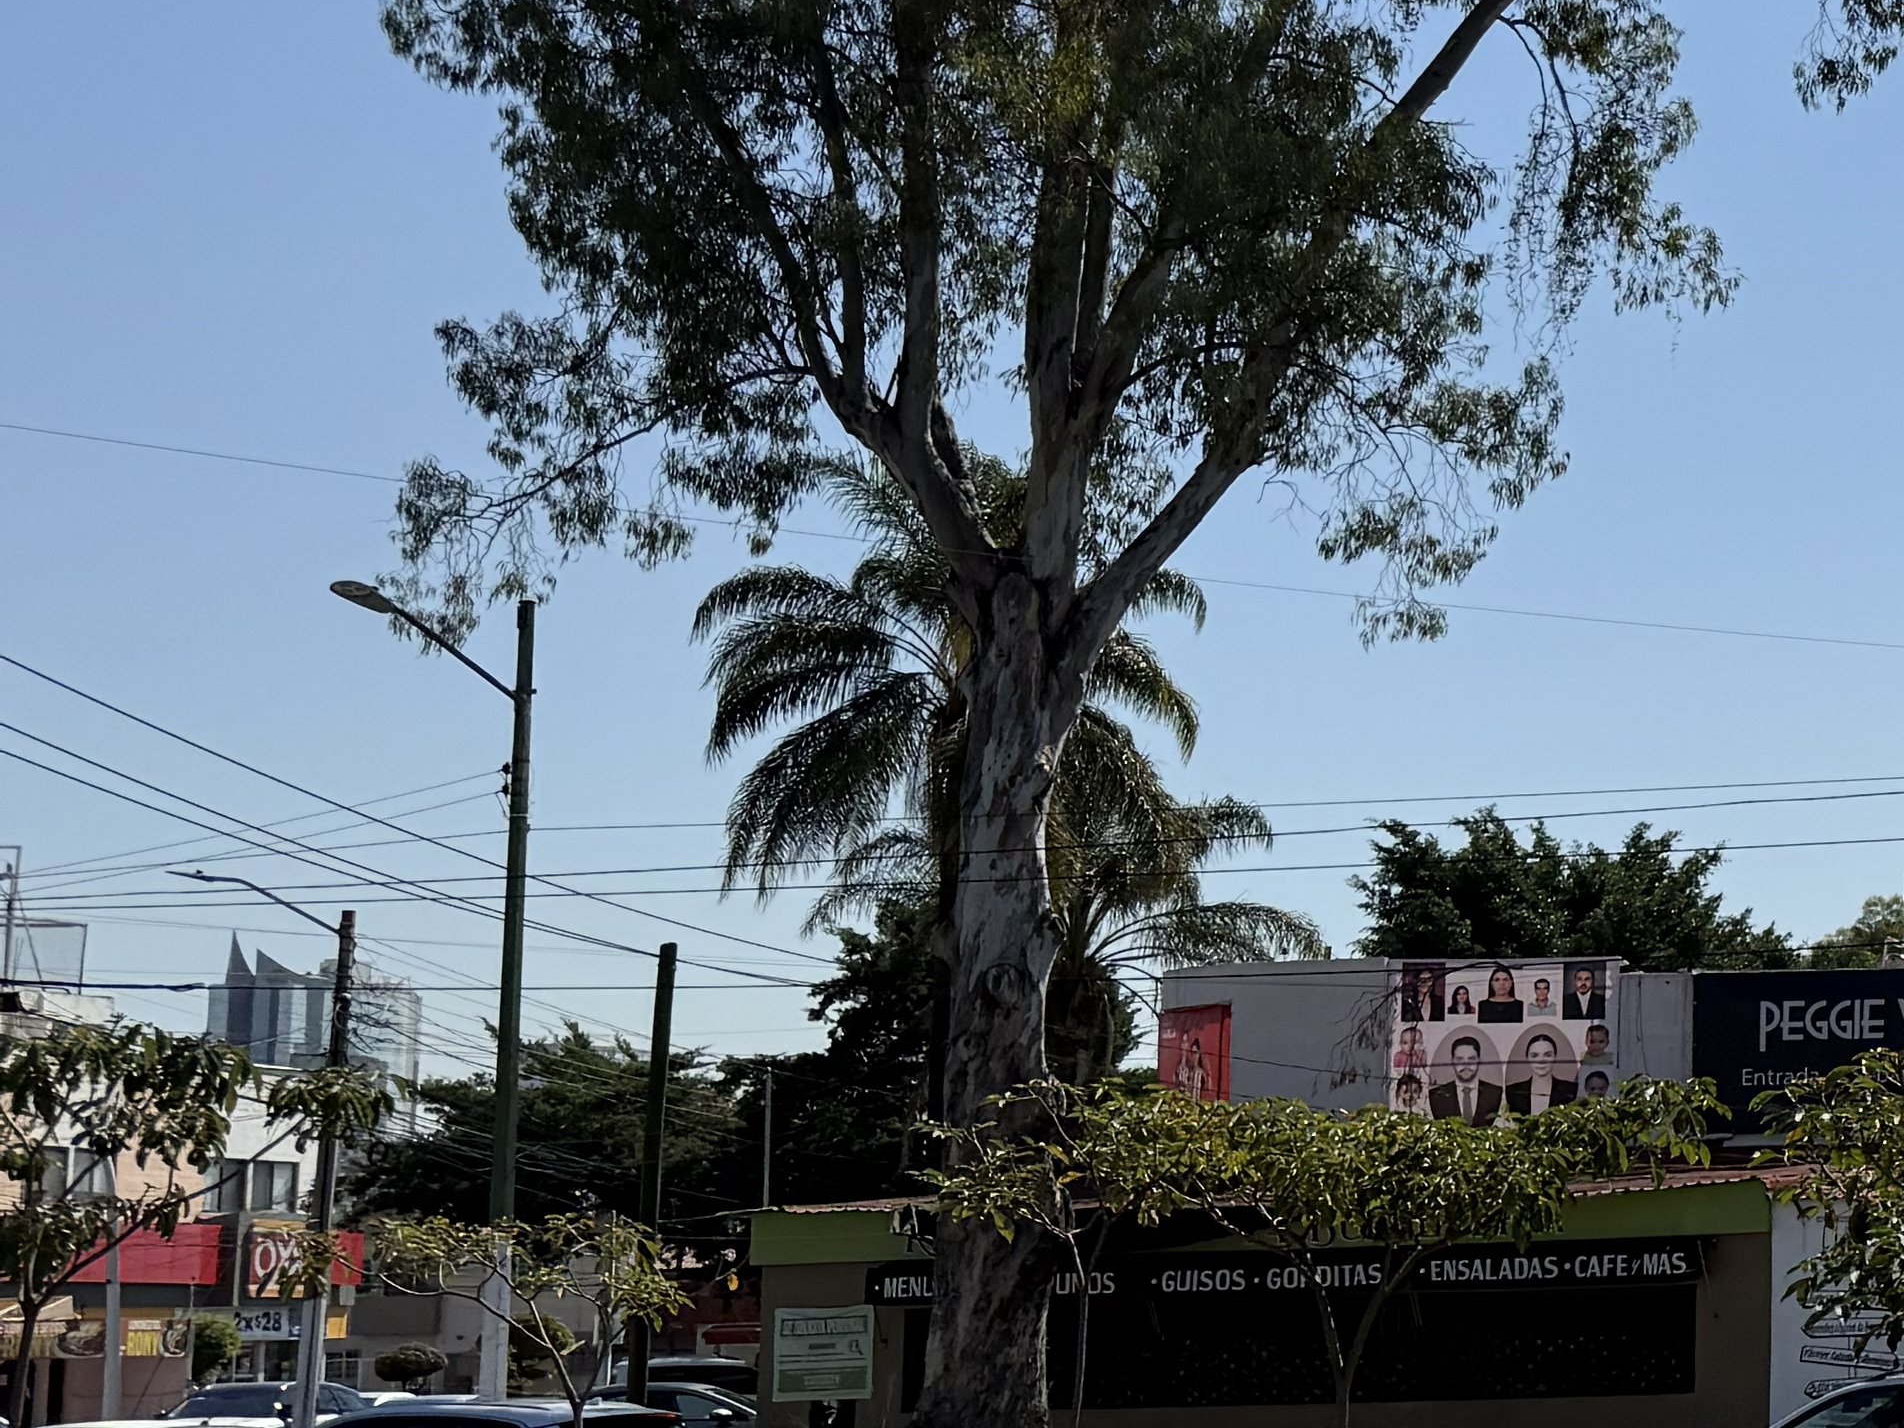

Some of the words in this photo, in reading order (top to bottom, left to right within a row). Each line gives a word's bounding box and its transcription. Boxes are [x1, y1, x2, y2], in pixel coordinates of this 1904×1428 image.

[1759, 997, 1885, 1052] PEGGIE
[1161, 1269, 1246, 1293] GUISOS
[1430, 1256, 1559, 1281] ENSALADAS
[1574, 1254, 1628, 1278] CAFE
[1643, 1246, 1687, 1276] MÁS
